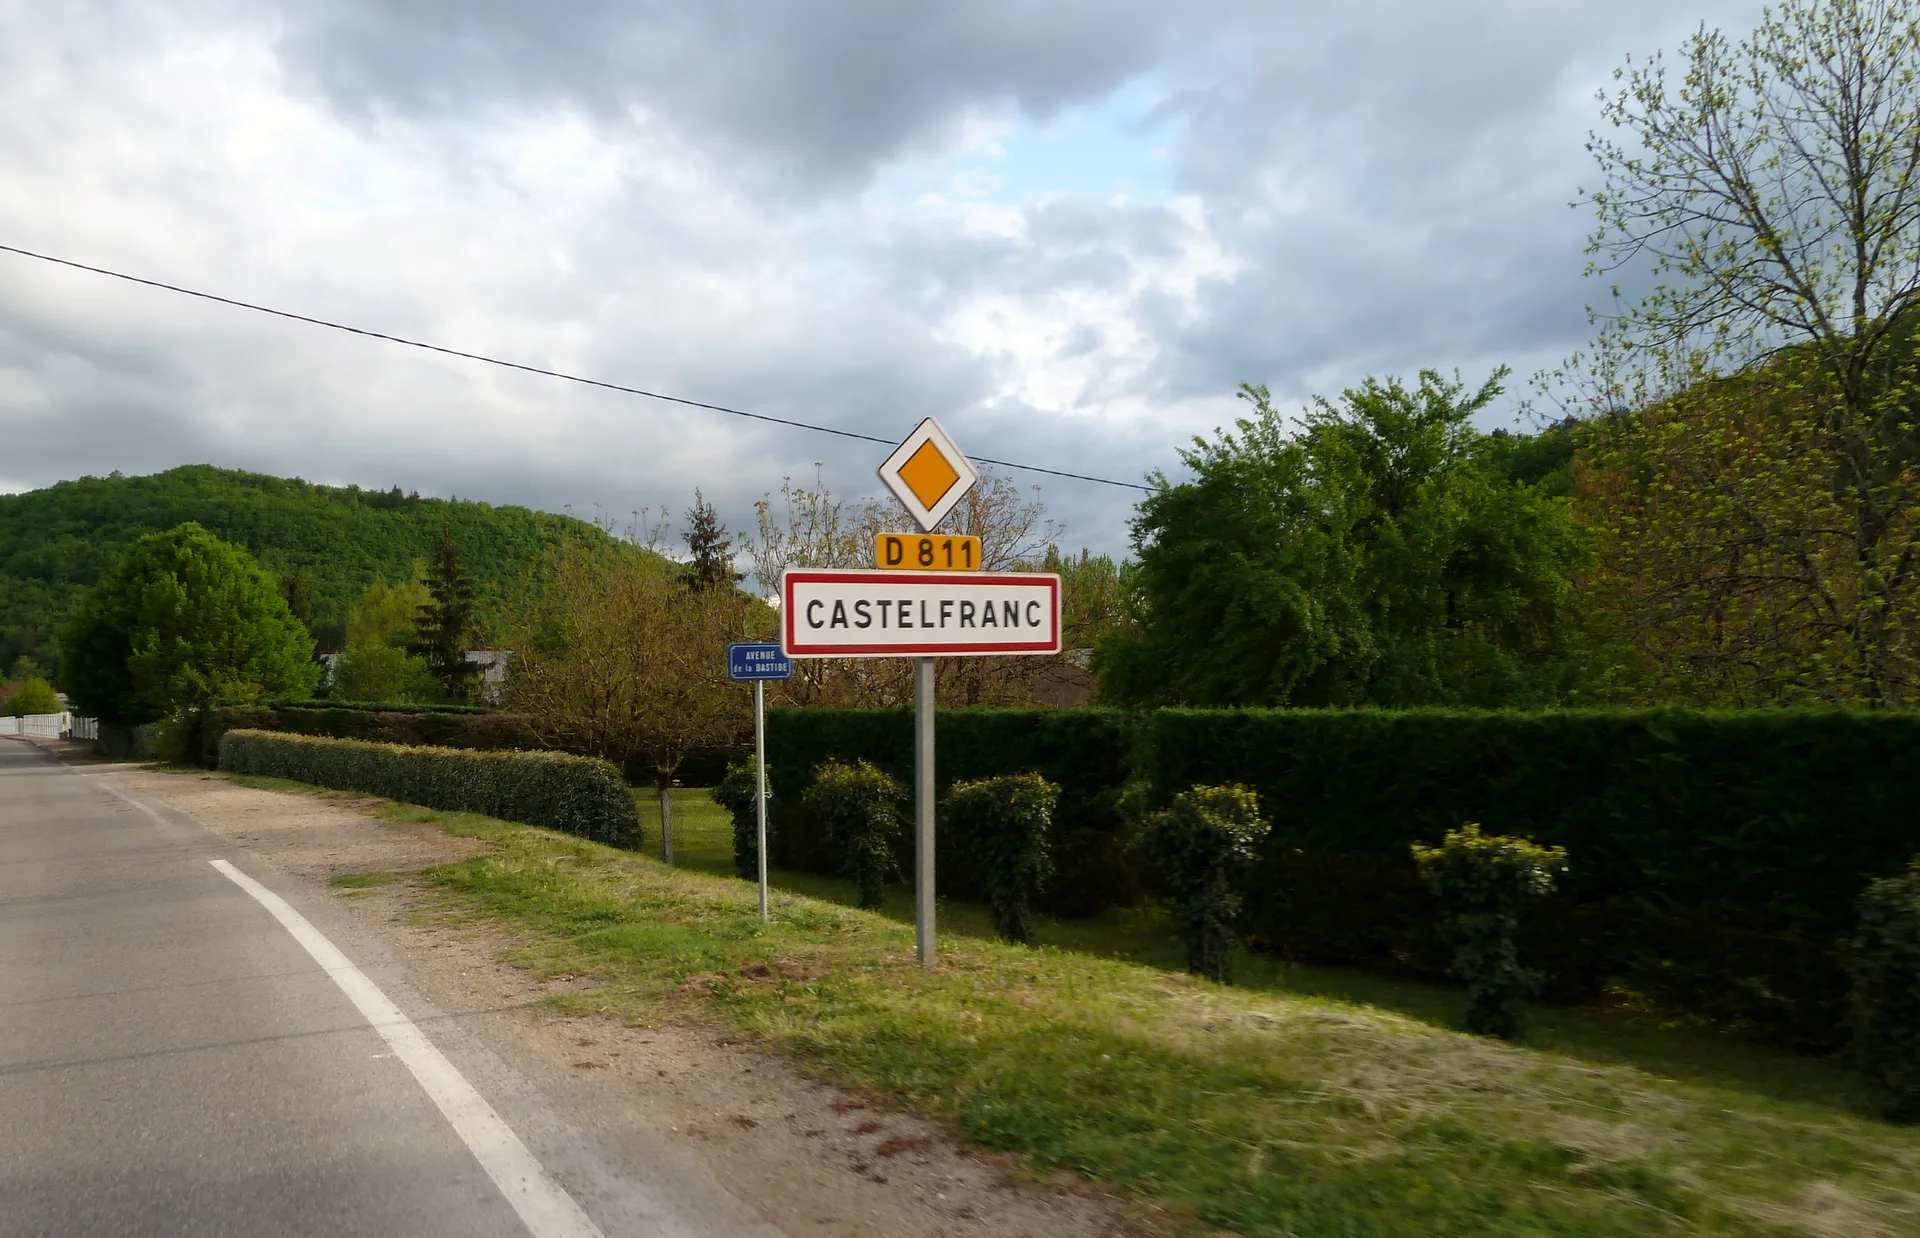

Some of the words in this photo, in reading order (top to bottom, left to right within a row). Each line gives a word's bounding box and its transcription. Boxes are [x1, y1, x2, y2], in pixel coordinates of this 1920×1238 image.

[886, 537, 903, 565] D
[918, 538, 971, 568] 811
[806, 599, 1041, 629] CASTELFRANC
[745, 651, 776, 660] AVENUE
[733, 664, 742, 672] de
[745, 664, 752, 672] la
[755, 663, 788, 672] BASTIDE
